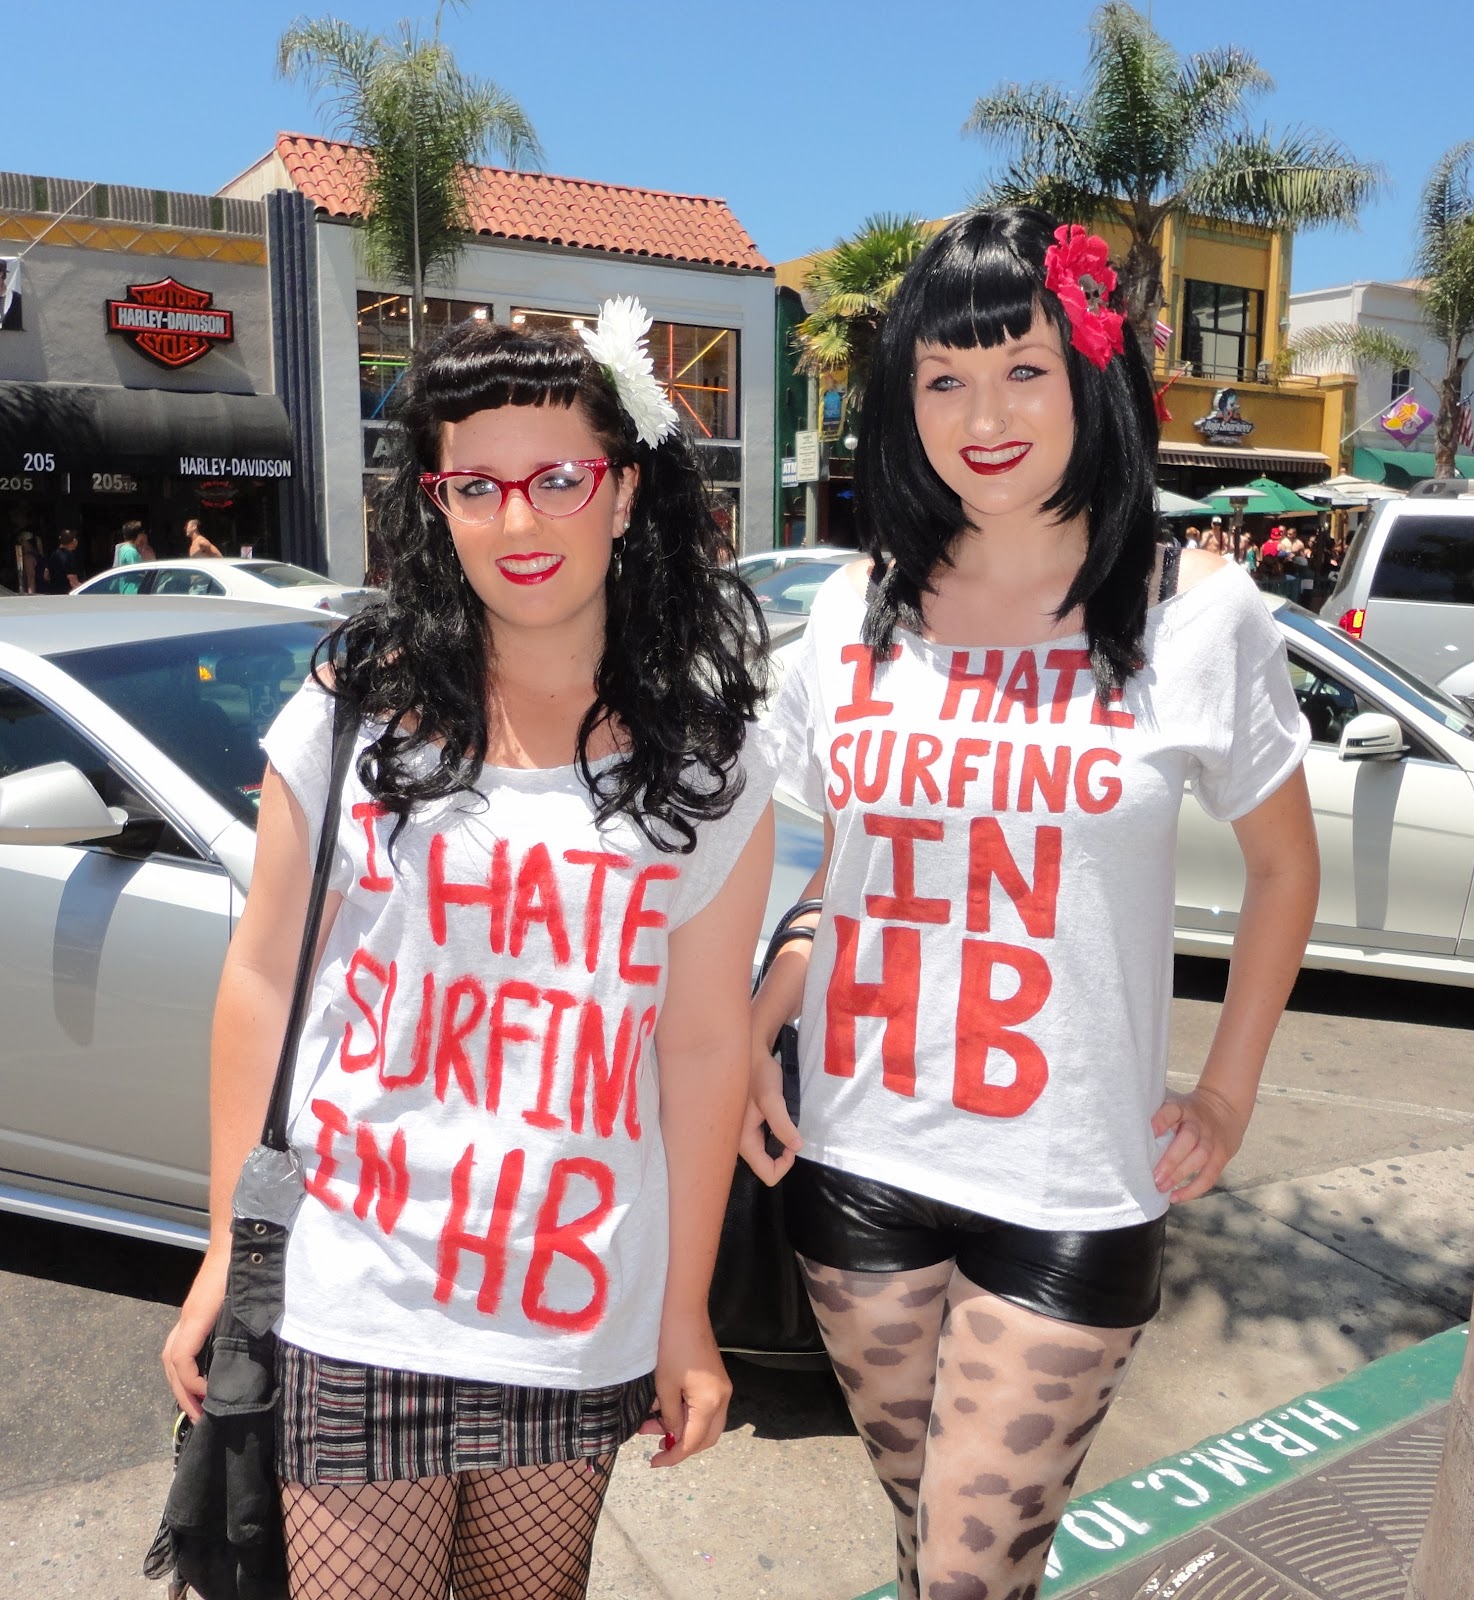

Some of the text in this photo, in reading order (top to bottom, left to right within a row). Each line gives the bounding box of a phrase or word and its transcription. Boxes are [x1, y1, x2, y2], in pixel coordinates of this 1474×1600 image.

[118, 307, 225, 334] HARLEY-DAVIDSON
[142, 287, 199, 308] MOTOR
[144, 333, 199, 359] CYCLES
[0, 477, 33, 491] 205
[23, 453, 55, 472] 205
[180, 457, 291, 477] HARLEY-DAVIDSON
[834, 643, 1143, 729] I HATE
[828, 729, 1123, 814] SURFING
[352, 801, 680, 986] I HATE
[863, 812, 1064, 939] IN
[823, 914, 1053, 1119] HB
[305, 1098, 616, 1333] IN HB
[1062, 1500, 1150, 1549] 10
